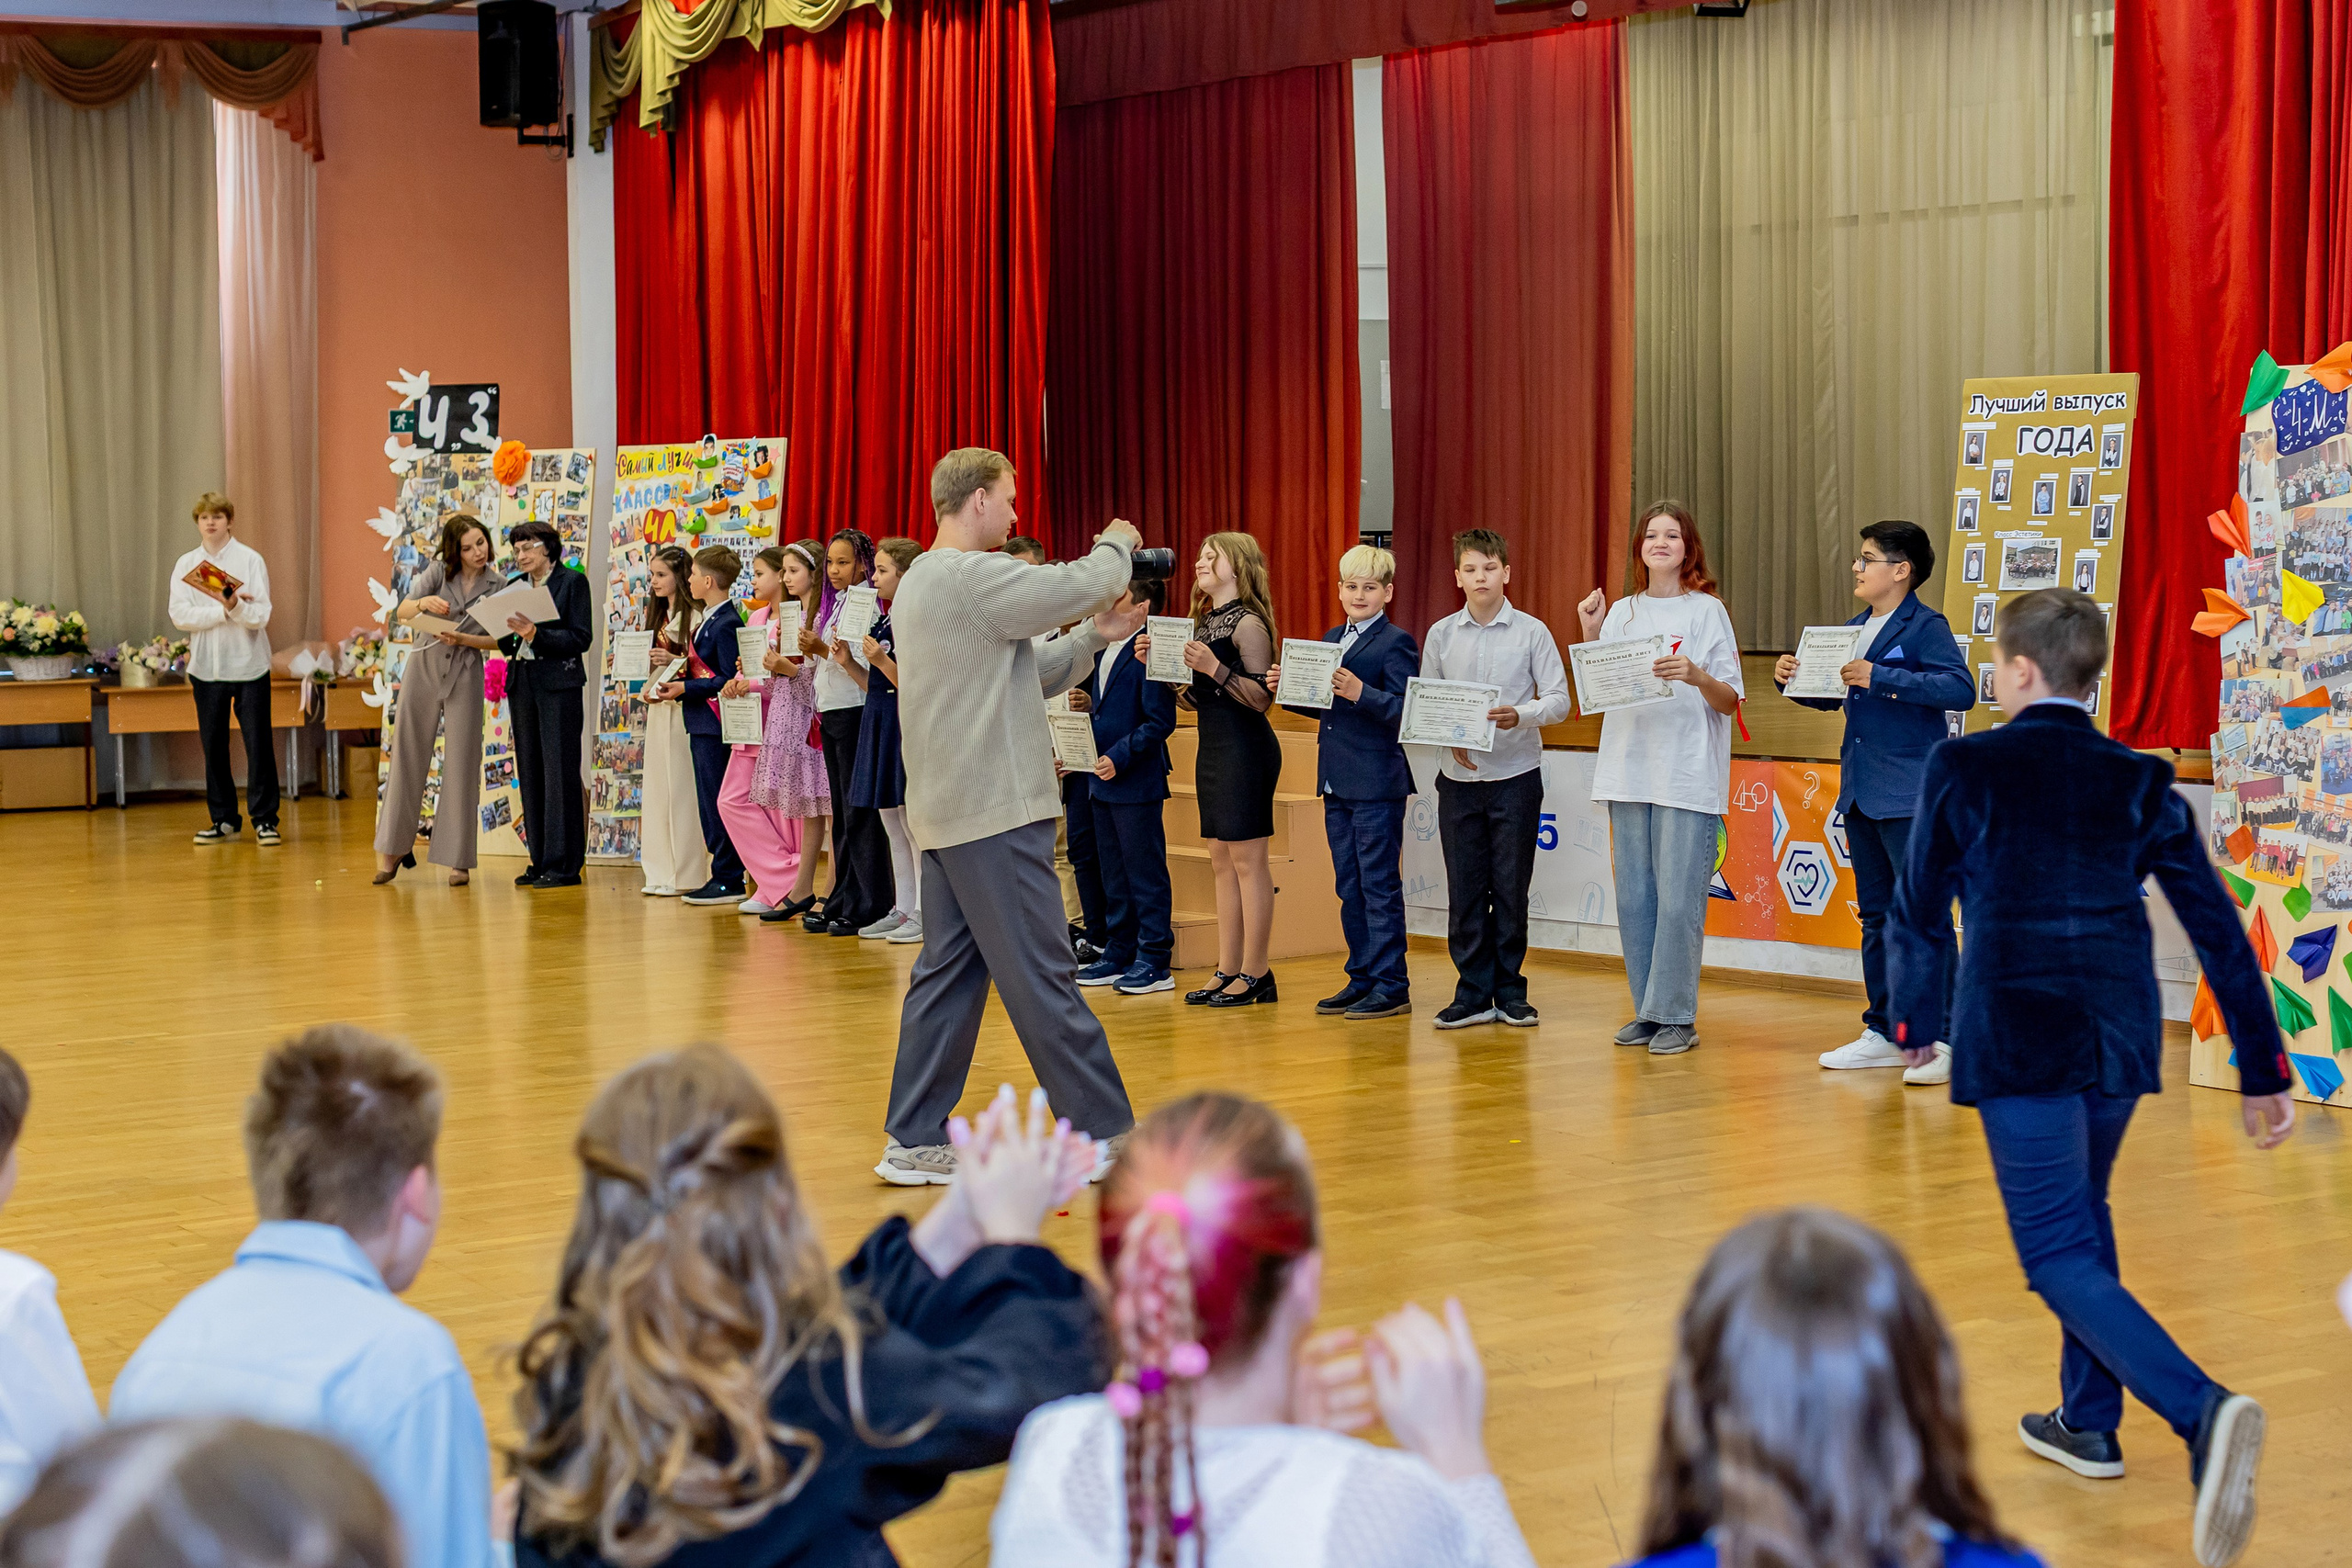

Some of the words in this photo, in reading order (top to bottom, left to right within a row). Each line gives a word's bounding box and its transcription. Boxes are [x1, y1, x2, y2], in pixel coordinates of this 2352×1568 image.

[1969, 391, 2046, 419] Лучший
[2053, 394, 2126, 415] выпуск
[2018, 427, 2094, 457] ГОДА
[617, 452, 654, 478] Самый
[1585, 653, 1633, 665] Похвальный
